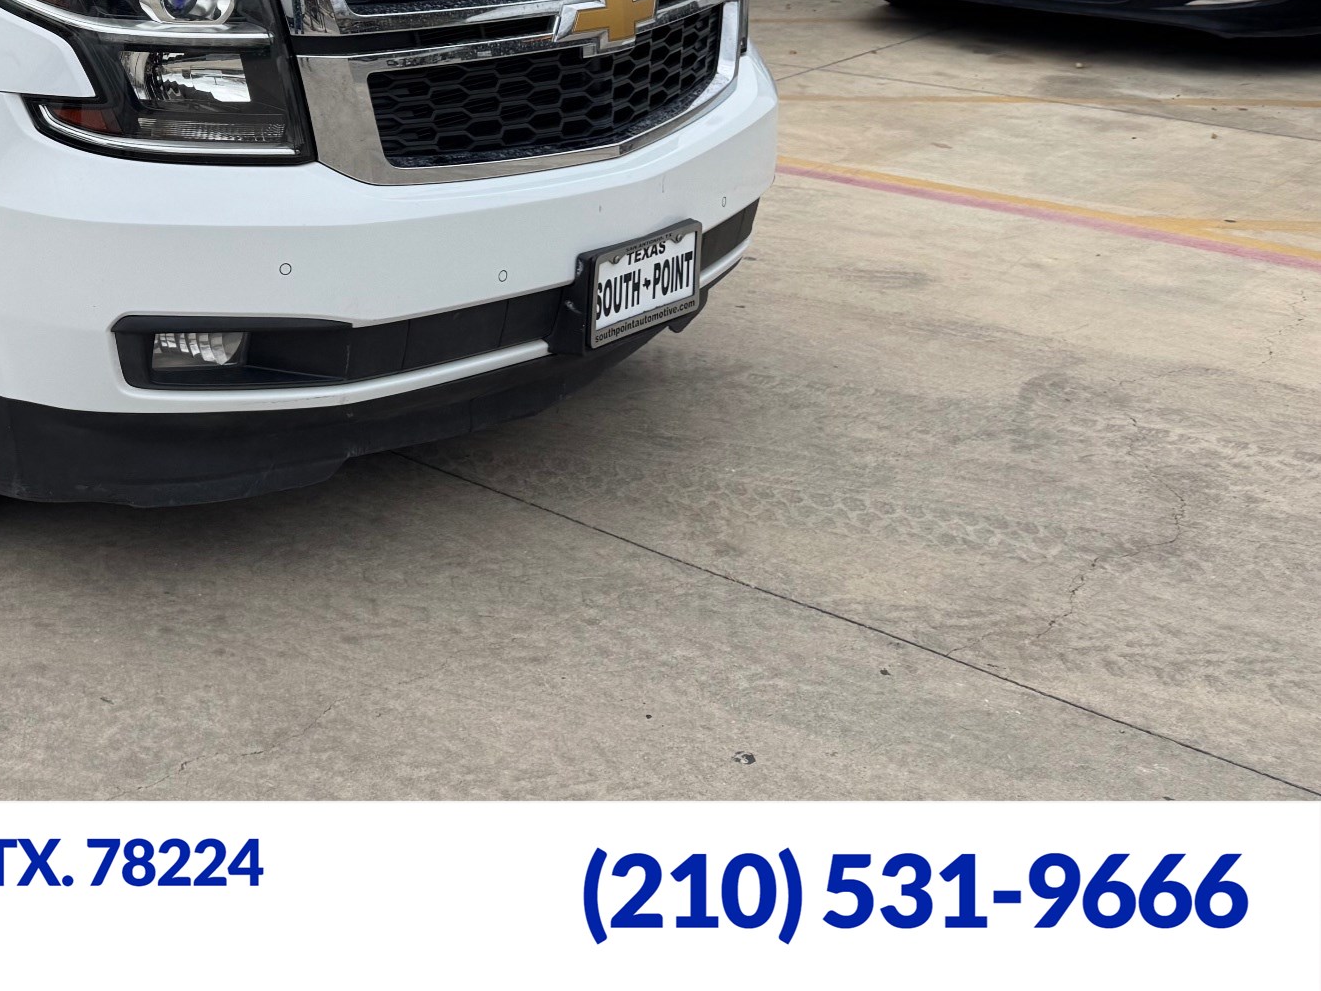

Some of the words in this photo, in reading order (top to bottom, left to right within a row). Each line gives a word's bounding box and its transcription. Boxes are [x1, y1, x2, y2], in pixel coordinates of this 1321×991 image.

[627, 240, 666, 266] TEXAS
[596, 269, 641, 320] SOUTH
[652, 251, 693, 299] POINT
[595, 299, 695, 343] southpointautomotive.com
